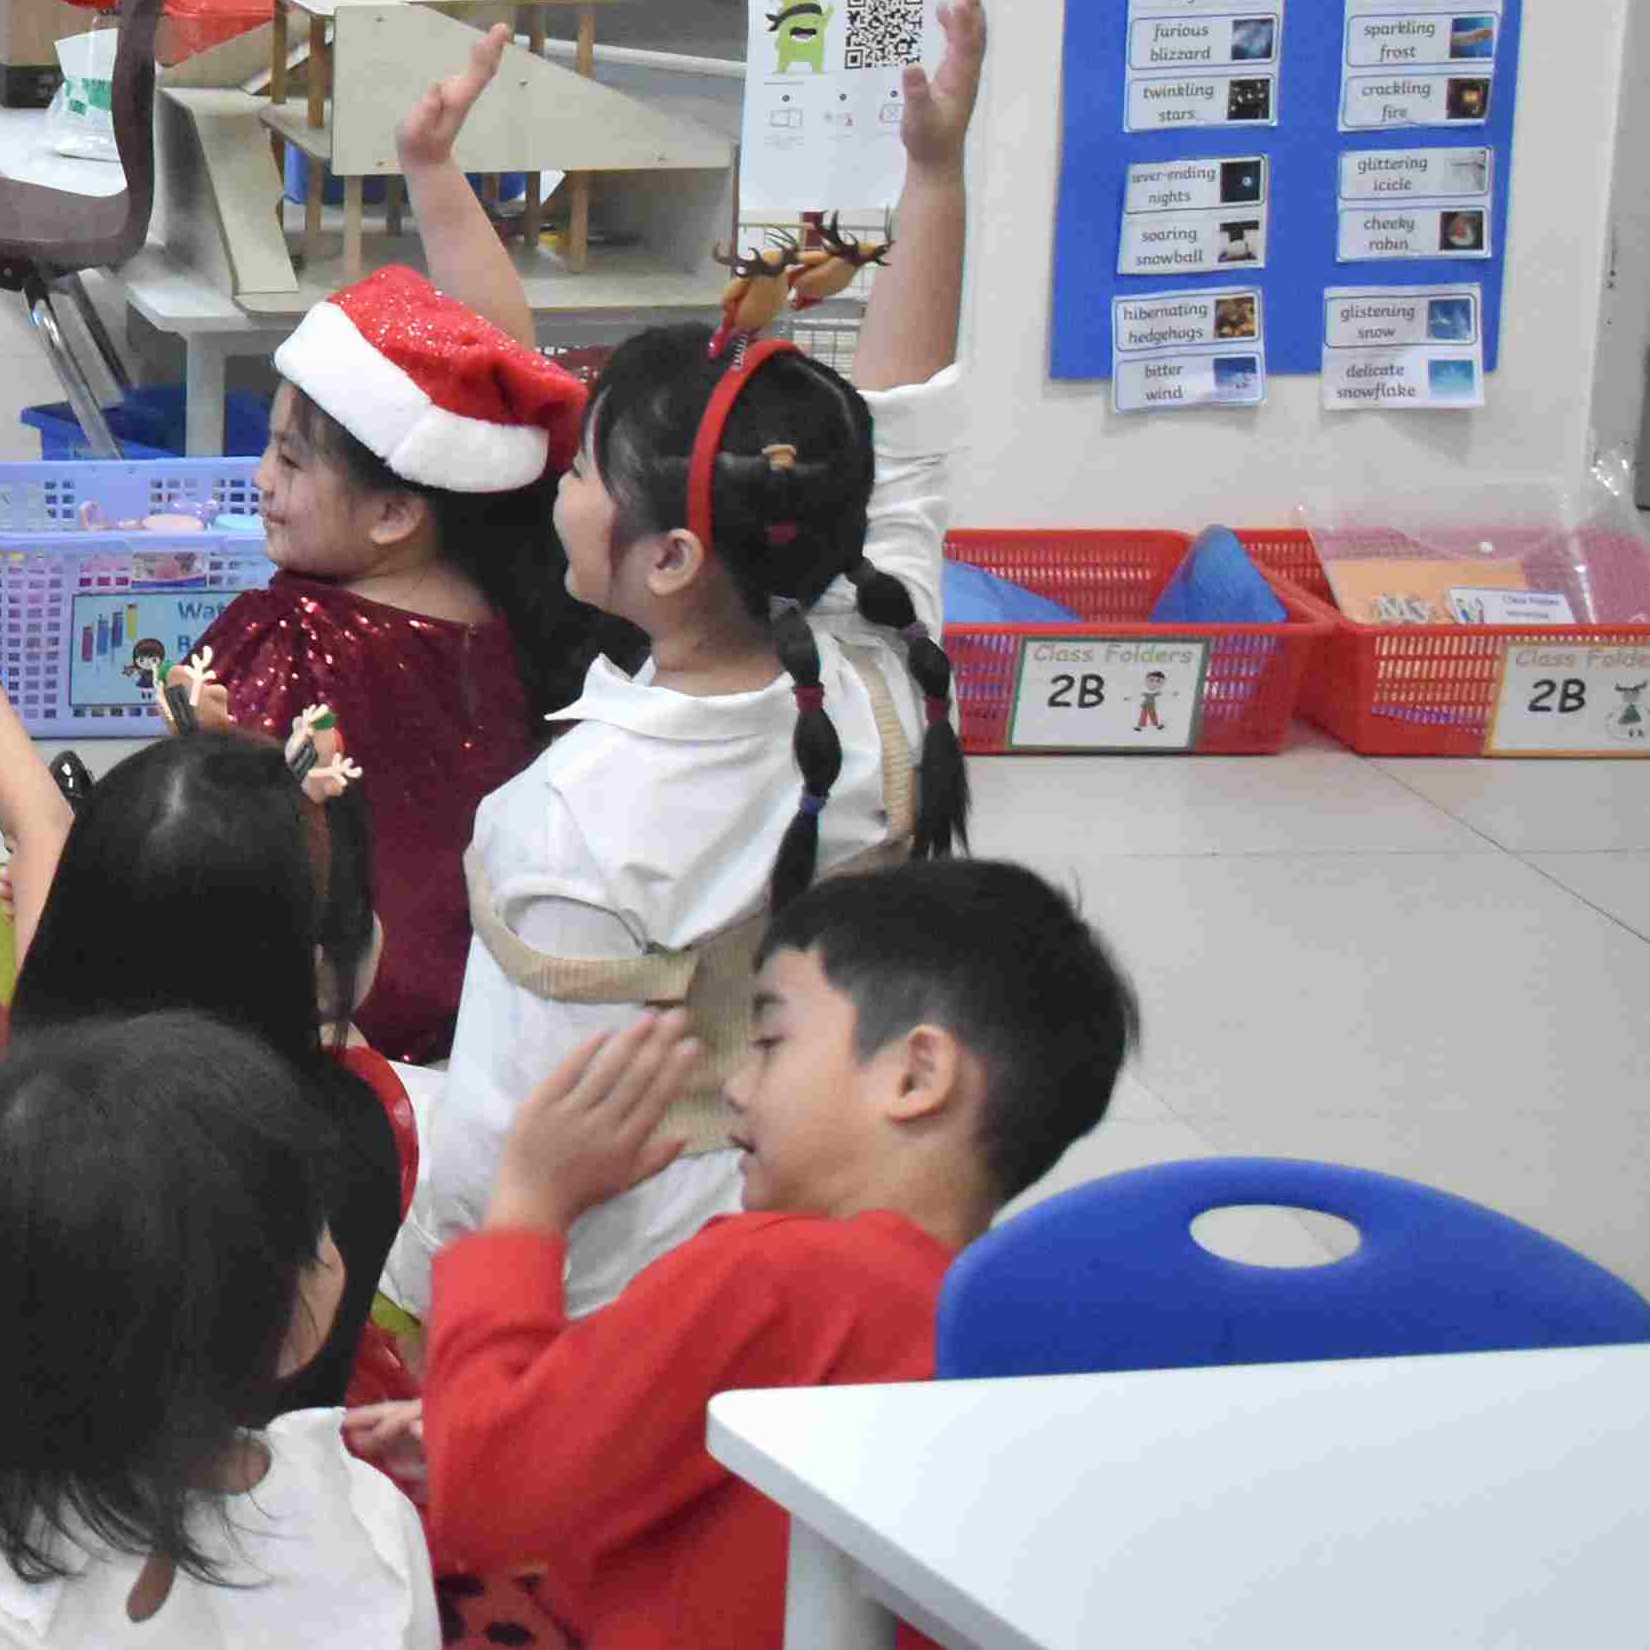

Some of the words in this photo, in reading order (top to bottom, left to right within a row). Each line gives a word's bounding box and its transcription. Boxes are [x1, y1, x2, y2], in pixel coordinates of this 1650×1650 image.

[1153, 23, 1210, 40] furious
[1363, 19, 1436, 38] sparkling
[1149, 46, 1212, 63] blizzard
[1378, 45, 1416, 61] frost
[1142, 83, 1215, 103] twinkling
[1361, 80, 1431, 100] crackling
[1158, 108, 1196, 122] stars
[1381, 105, 1408, 121] fire
[1357, 155, 1428, 175] glittering
[1147, 188, 1192, 206] nights
[1363, 216, 1416, 234] cheeky
[1141, 226, 1198, 245] soaring
[1368, 237, 1410, 252] robin
[1135, 248, 1204, 267] snowball
[1122, 302, 1209, 323] hibernating
[1340, 303, 1416, 323] glistening
[1127, 325, 1204, 344] hedgehogs
[1356, 326, 1397, 340] snow
[1143, 362, 1184, 378] bitter
[1345, 362, 1405, 378] delicate
[1145, 385, 1183, 401] wind
[1336, 383, 1416, 401] snowflake
[1033, 642, 1094, 665] Class
[1103, 643, 1194, 666] Folders
[1515, 650, 1577, 668] Class
[1047, 673, 1106, 710] 2B
[1528, 677, 1587, 714] 2B
